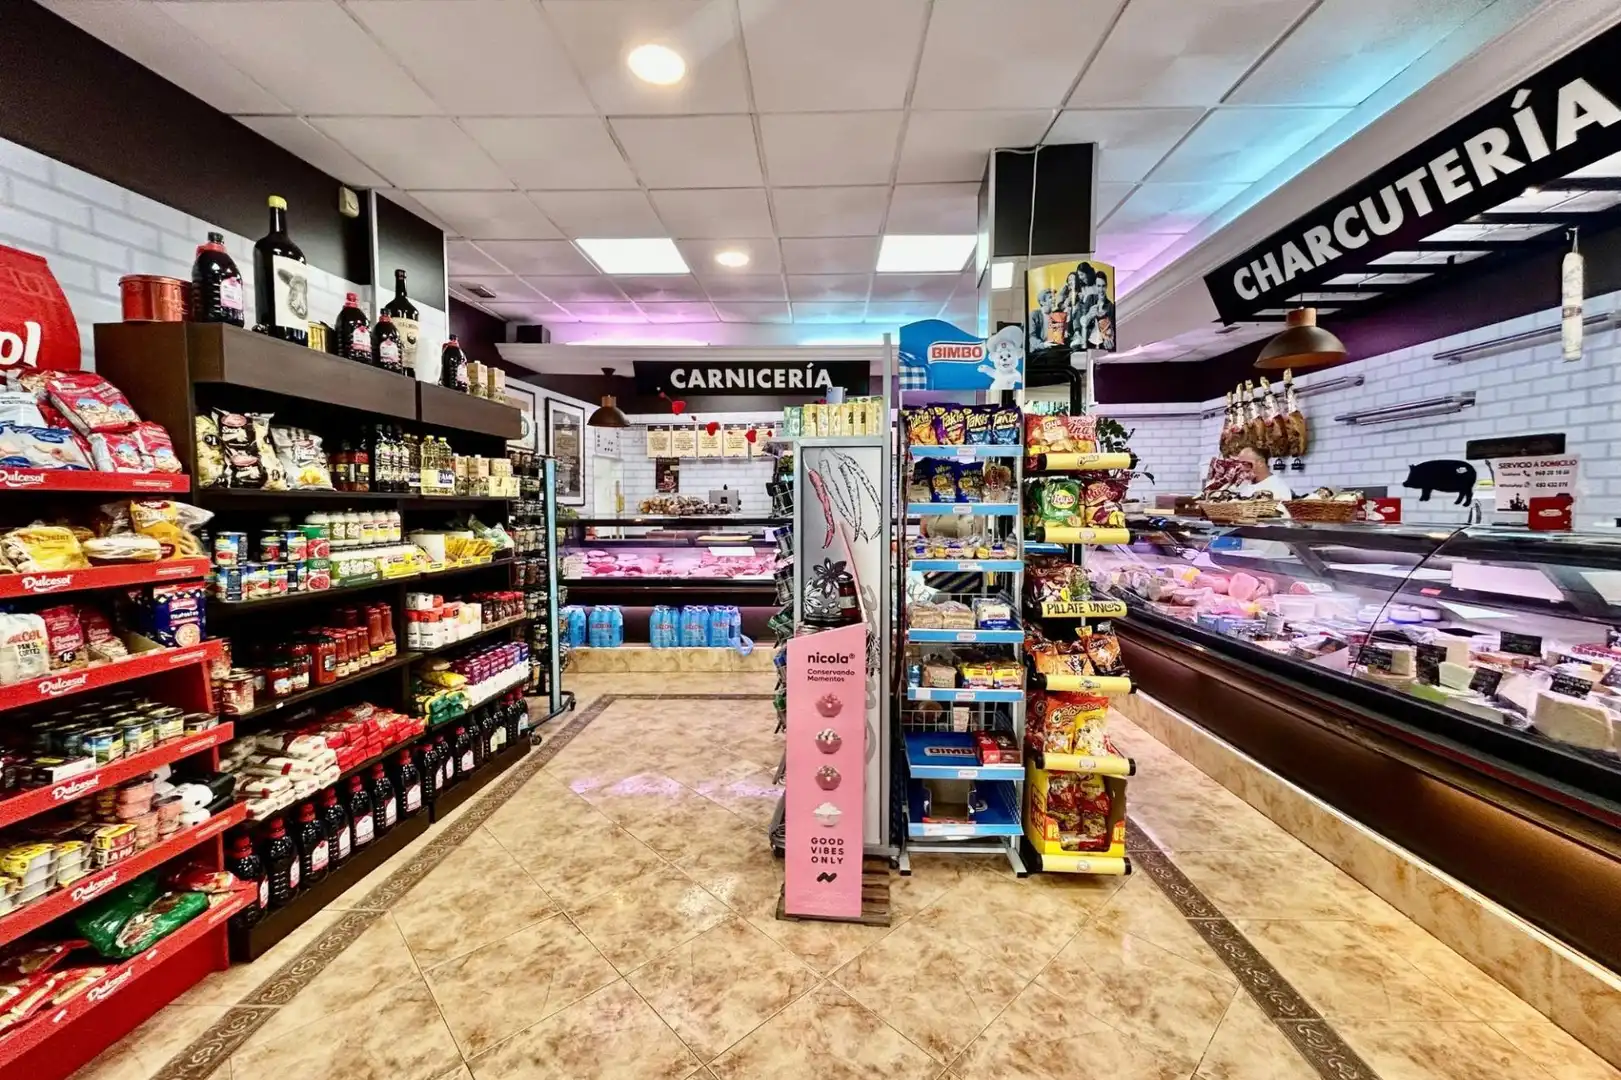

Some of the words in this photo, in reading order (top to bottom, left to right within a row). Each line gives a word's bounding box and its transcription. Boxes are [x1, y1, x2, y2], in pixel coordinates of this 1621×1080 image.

[1232, 77, 1621, 301] CHARCUTERÍA
[932, 346, 983, 359] BIMBO
[670, 362, 833, 389] CARNICERÍA
[1498, 461, 1532, 469] SERVICIO
[1540, 459, 1577, 468] DOMICILIO
[22, 574, 73, 592] Dulcesol
[807, 668, 855, 676] Conservando
[39, 674, 88, 694] Dulcesol
[52, 774, 101, 800] Dulcesol
[811, 837, 844, 845] GOOD
[811, 846, 844, 855] VIBES
[811, 856, 843, 864] ONLY
